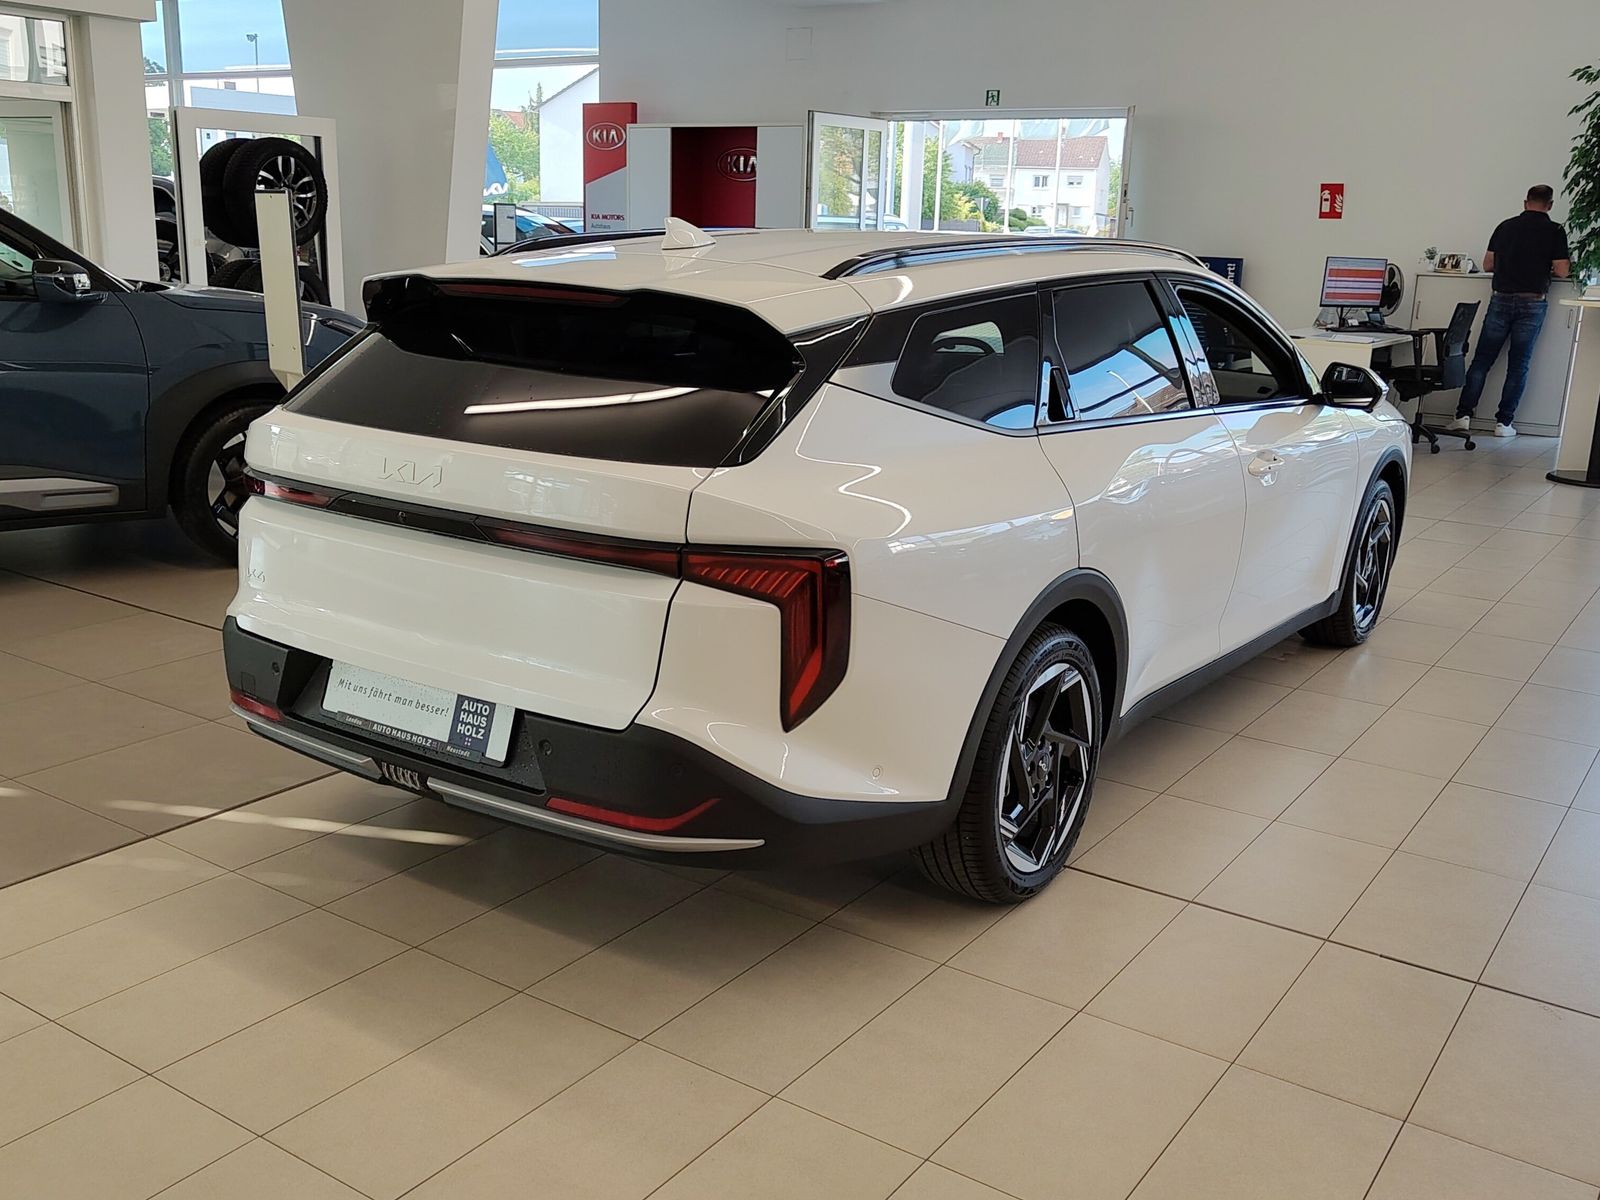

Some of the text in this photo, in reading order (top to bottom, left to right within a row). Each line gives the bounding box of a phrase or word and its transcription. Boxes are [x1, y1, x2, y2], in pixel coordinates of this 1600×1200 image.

[592, 128, 620, 144] KIA
[727, 155, 757, 174] KIA
[378, 457, 443, 488] KIA
[337, 678, 450, 717] Mit uns fährt man besser!
[461, 700, 490, 716] AUTO
[459, 711, 488, 728] HAUS
[456, 722, 486, 740] HOLZ
[411, 734, 432, 747] HOLZ
